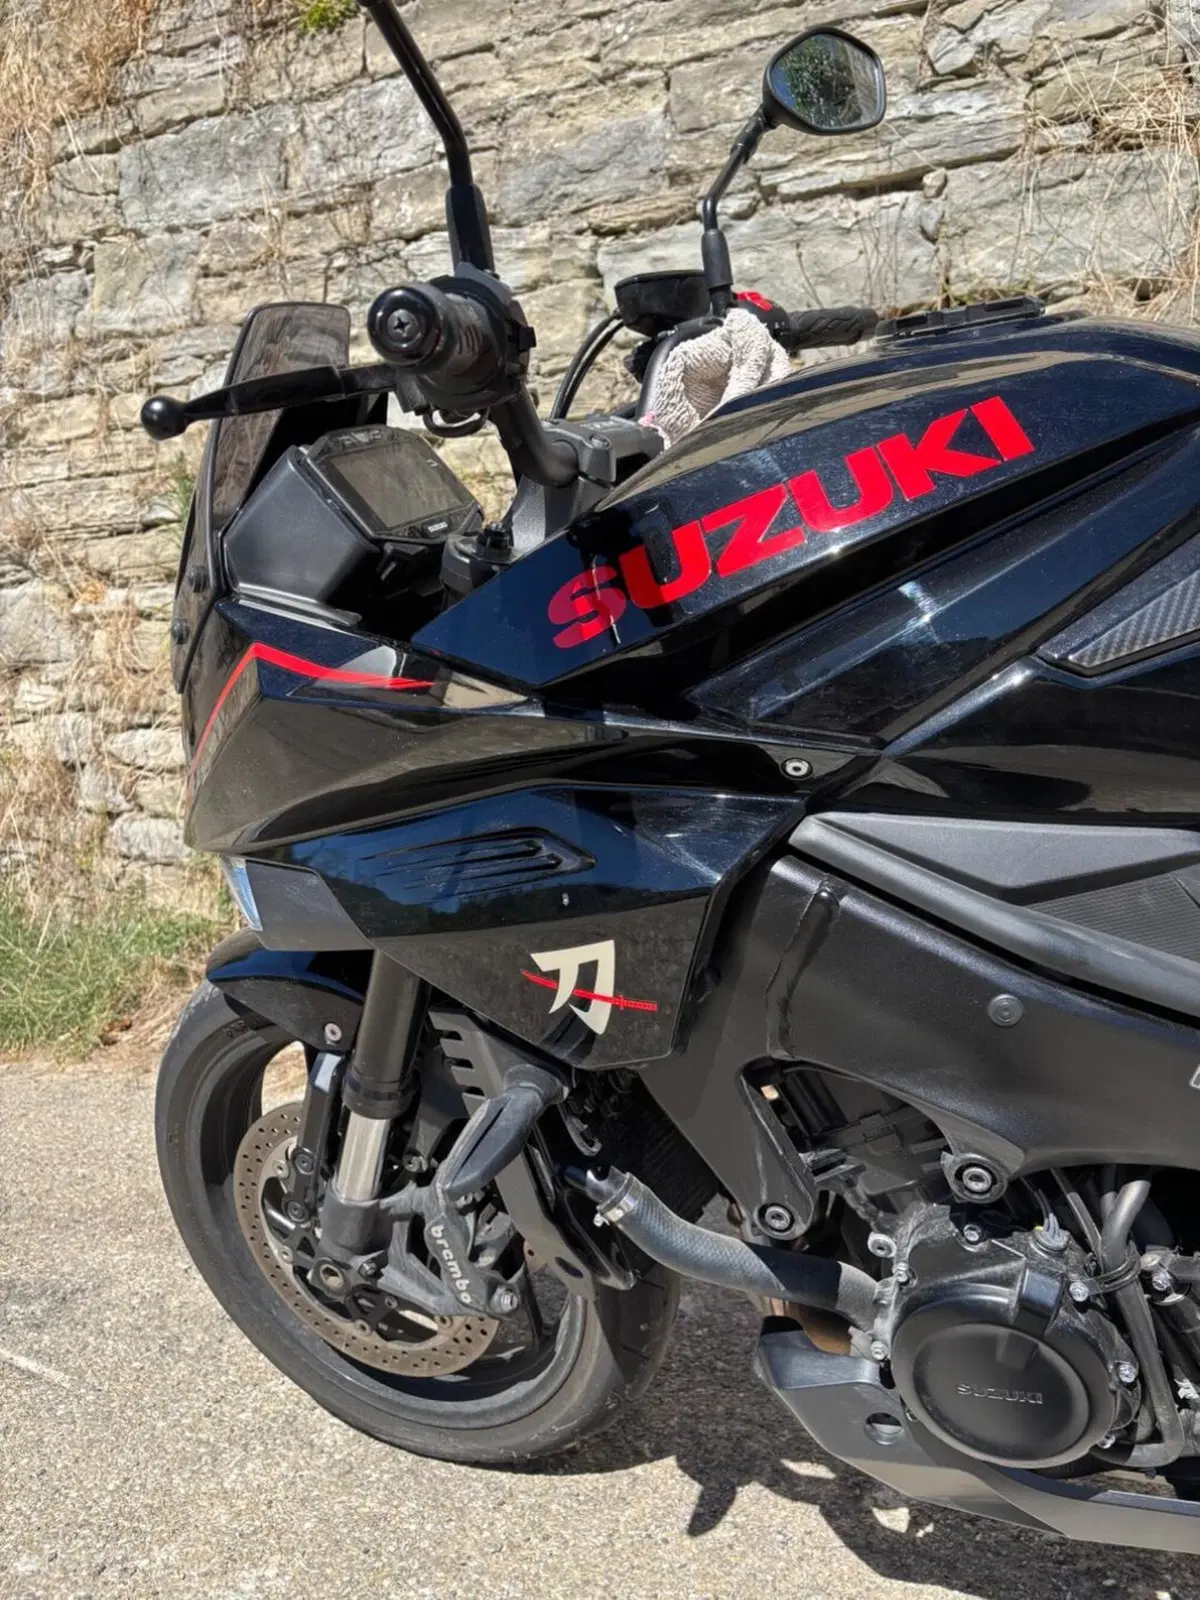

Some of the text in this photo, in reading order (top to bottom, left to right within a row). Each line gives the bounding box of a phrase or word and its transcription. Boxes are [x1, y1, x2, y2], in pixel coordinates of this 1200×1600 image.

[548, 396, 1035, 649] SUZUKI
[530, 940, 615, 1034] 刀
[431, 1224, 472, 1304] brembo
[956, 1383, 1043, 1404] SUZUKI
